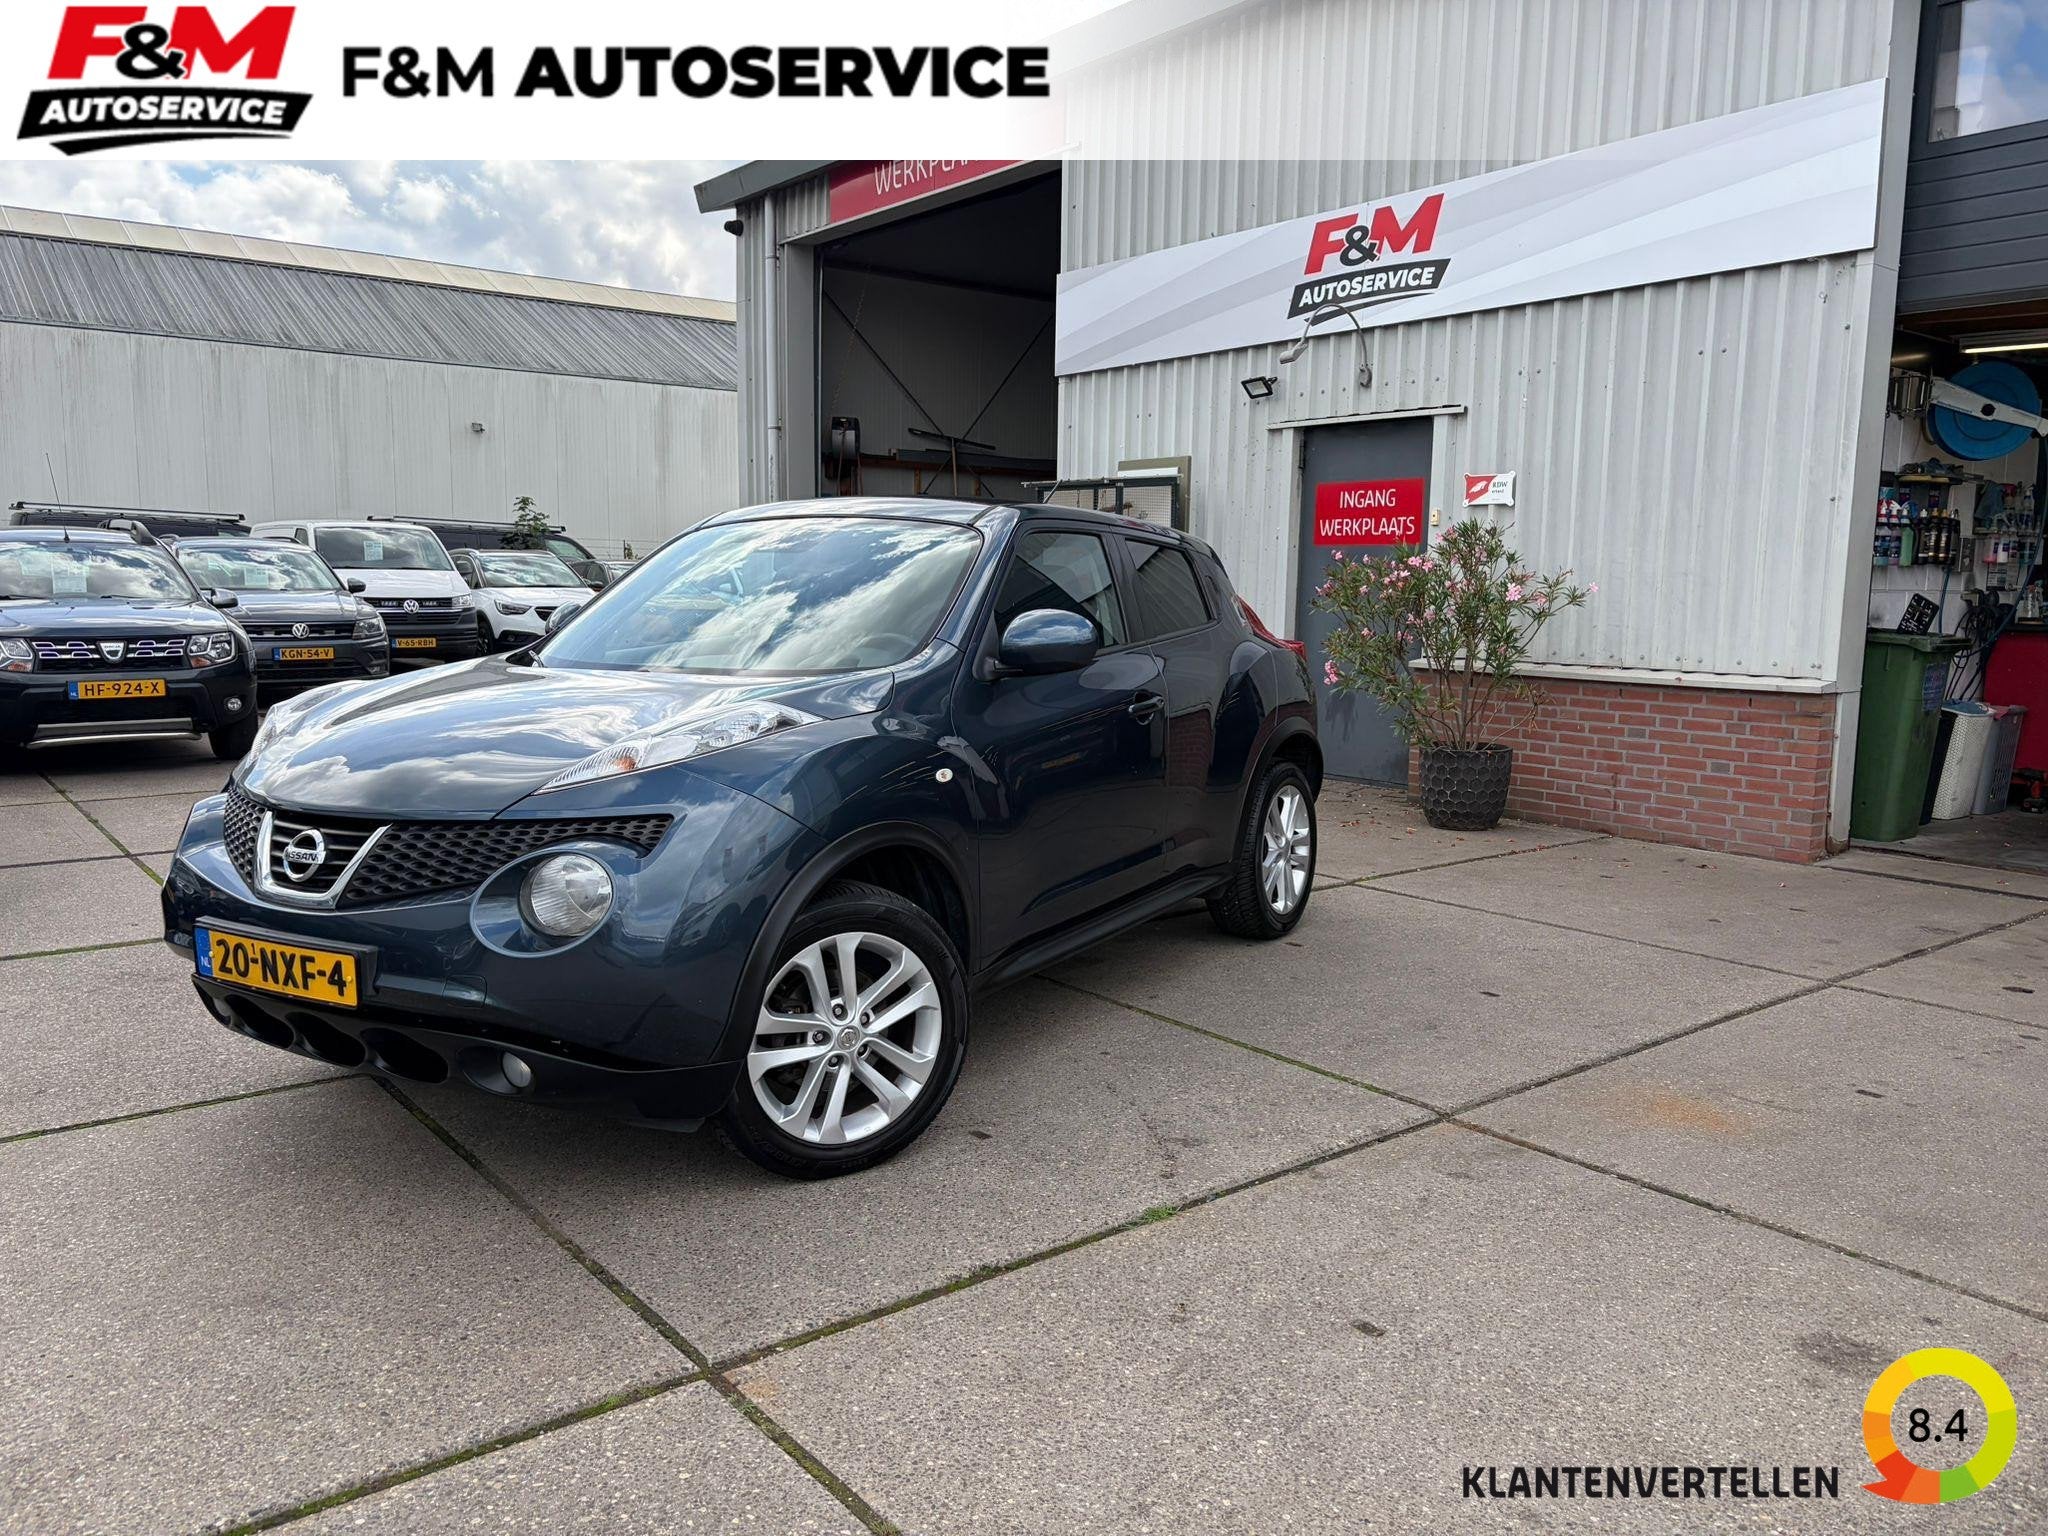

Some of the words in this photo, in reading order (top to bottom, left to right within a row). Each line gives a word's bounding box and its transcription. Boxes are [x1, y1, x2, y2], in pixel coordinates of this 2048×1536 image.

[1304, 193, 1445, 275] F&M
[1298, 266, 1436, 308] AUTOSERVICE
[1339, 488, 1396, 509] INGANG
[1319, 516, 1416, 537] WERKPLAATS
[280, 648, 330, 659] KGN-54-V
[84, 681, 160, 697] HF-924-X
[215, 938, 347, 997] 20-NXF-4
